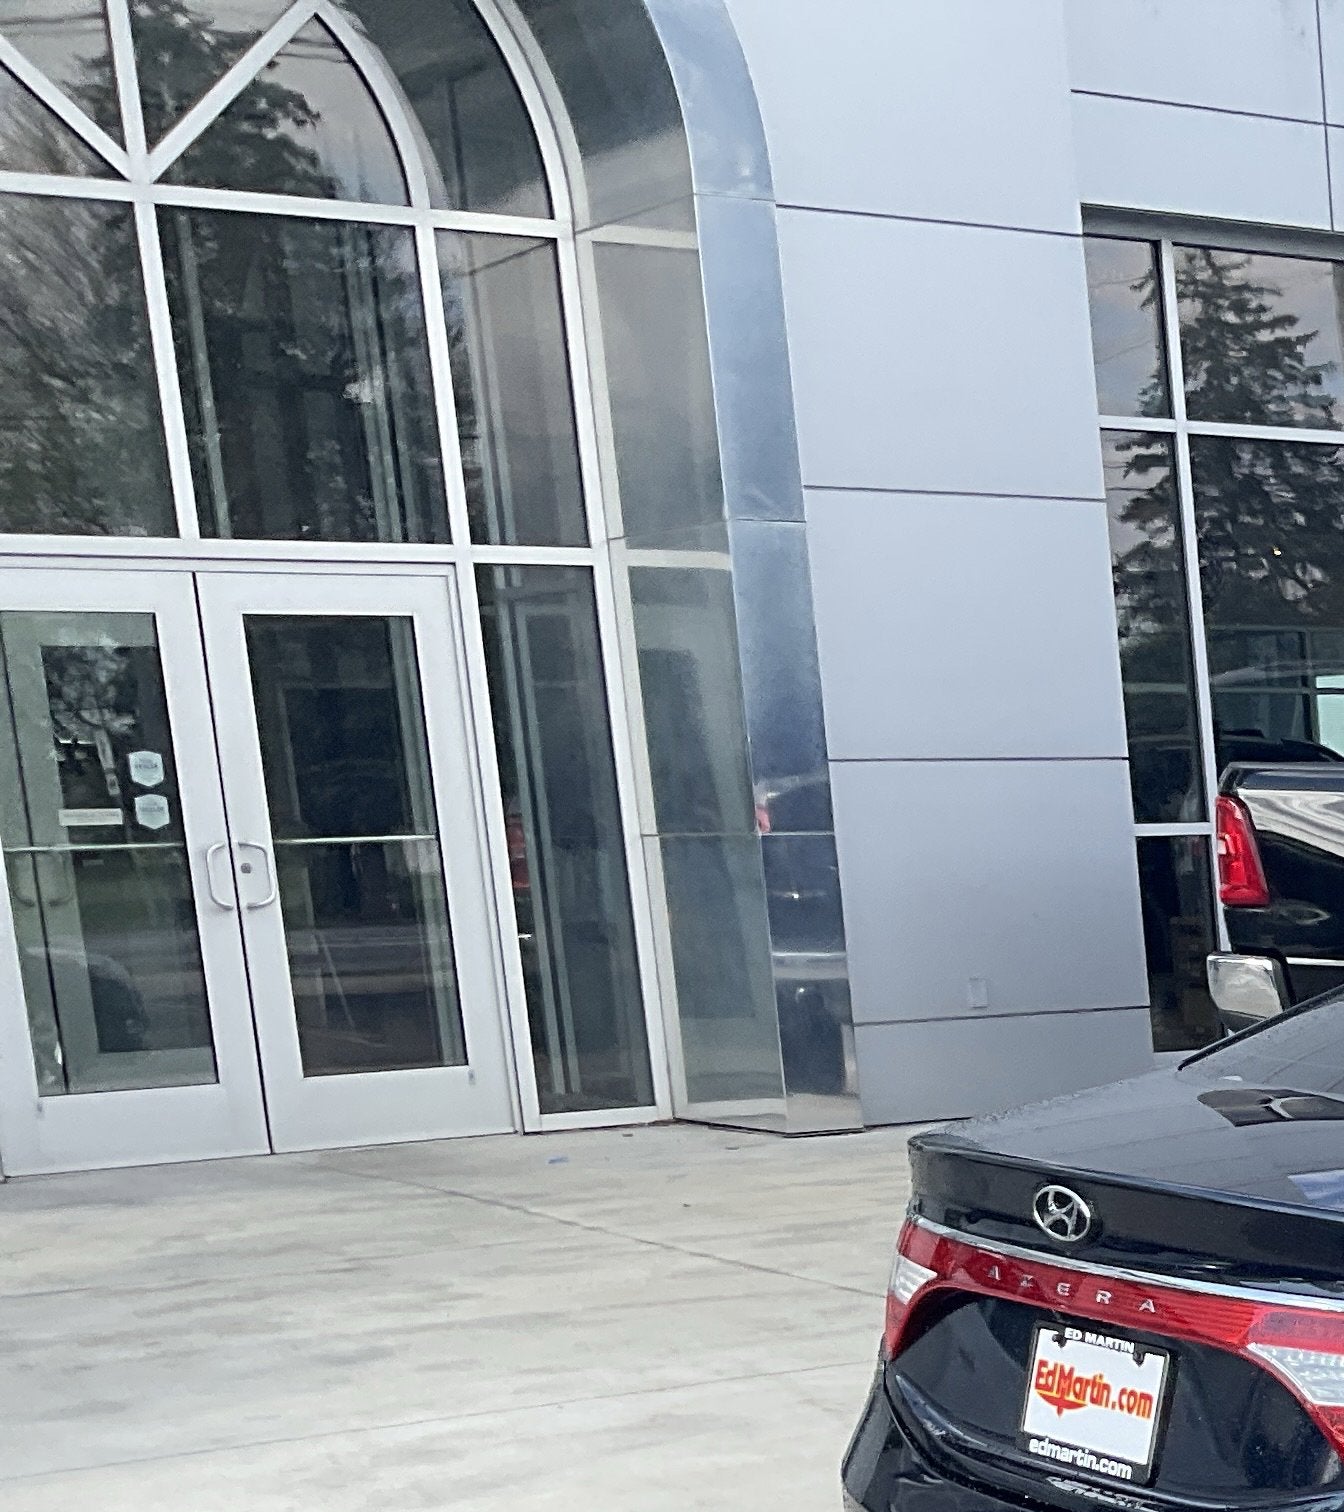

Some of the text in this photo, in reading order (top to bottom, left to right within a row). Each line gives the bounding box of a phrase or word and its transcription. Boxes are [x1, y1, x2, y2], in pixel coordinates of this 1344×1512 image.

[987, 1264, 1157, 1314] AZERA
[1064, 1327, 1135, 1354] ED MARTIN
[1034, 1359, 1154, 1420] EdMartin.com
[1028, 1437, 1133, 1480] edmartin.com
